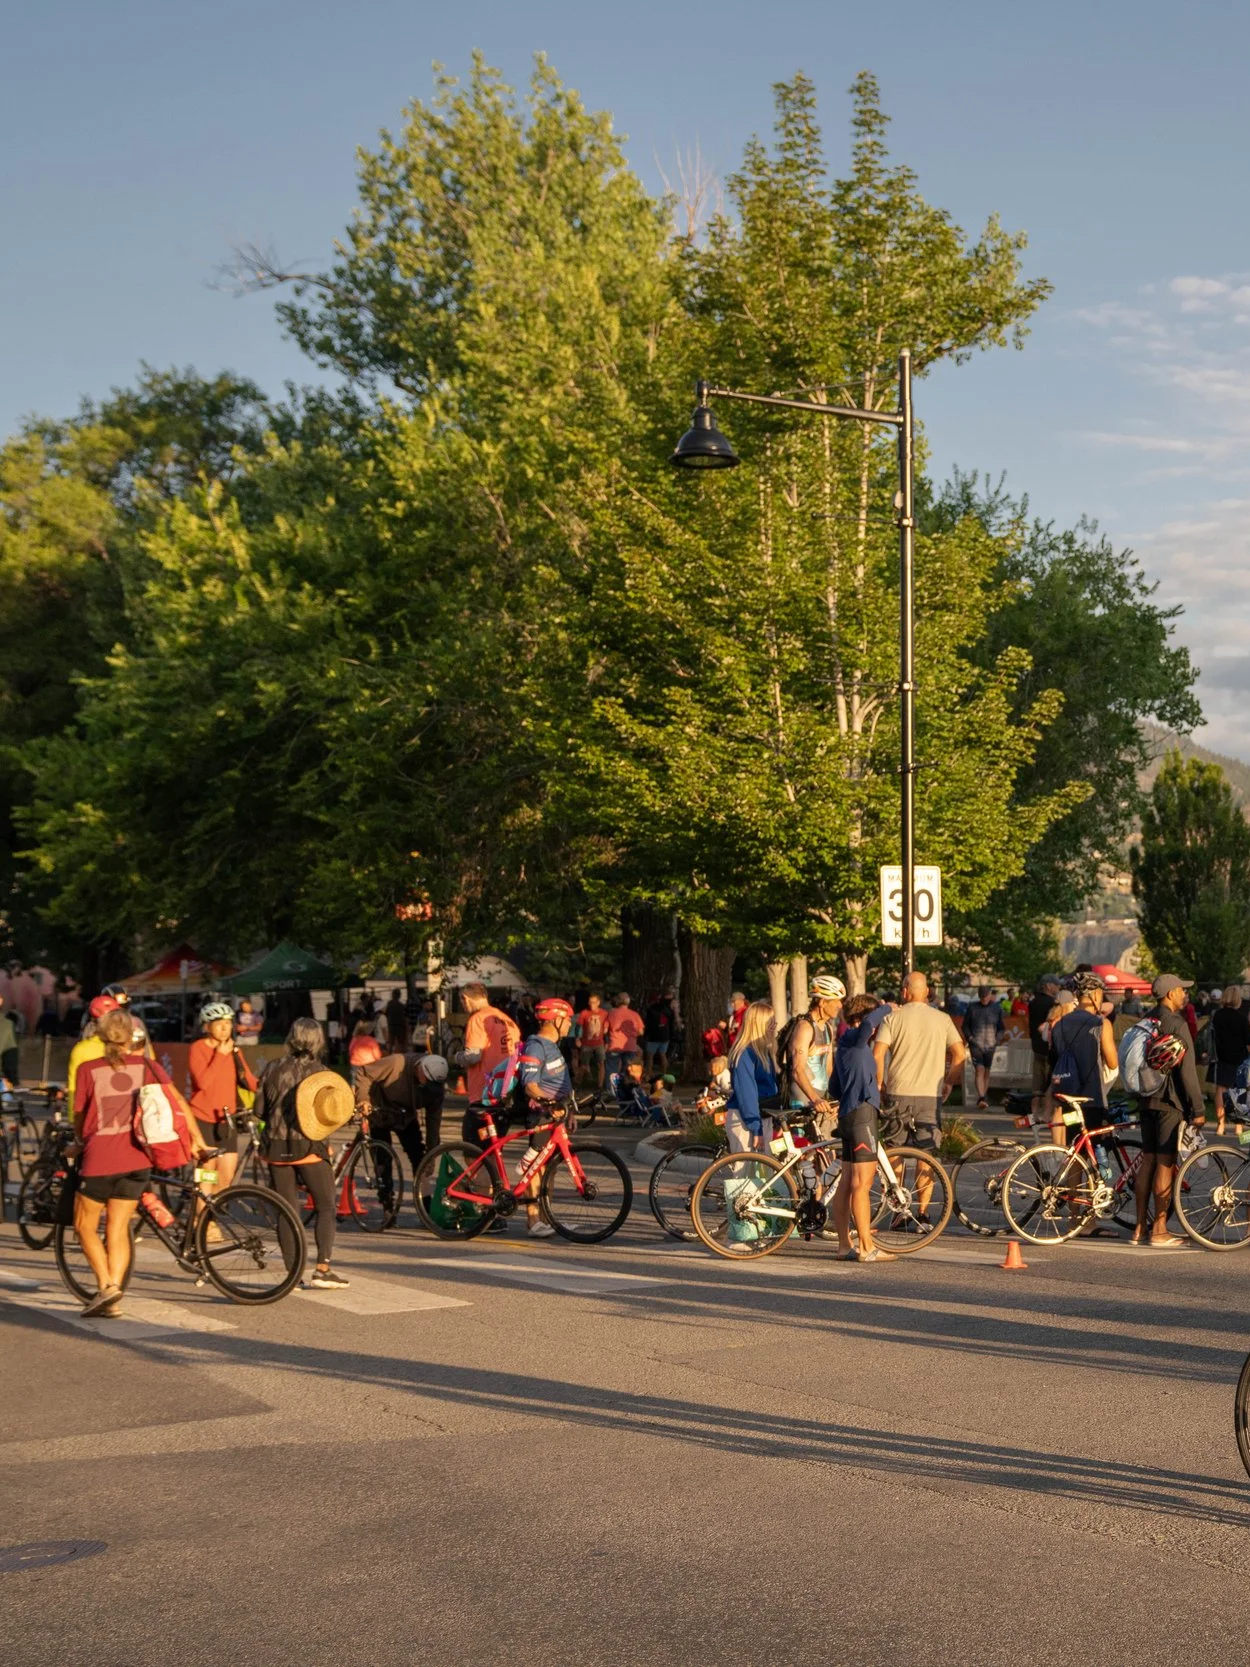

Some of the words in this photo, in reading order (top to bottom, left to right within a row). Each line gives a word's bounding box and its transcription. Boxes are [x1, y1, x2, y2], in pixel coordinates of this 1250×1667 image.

[888, 888, 934, 922] 30
[894, 927, 930, 939] k/h
[520, 1140, 554, 1184] TREK
